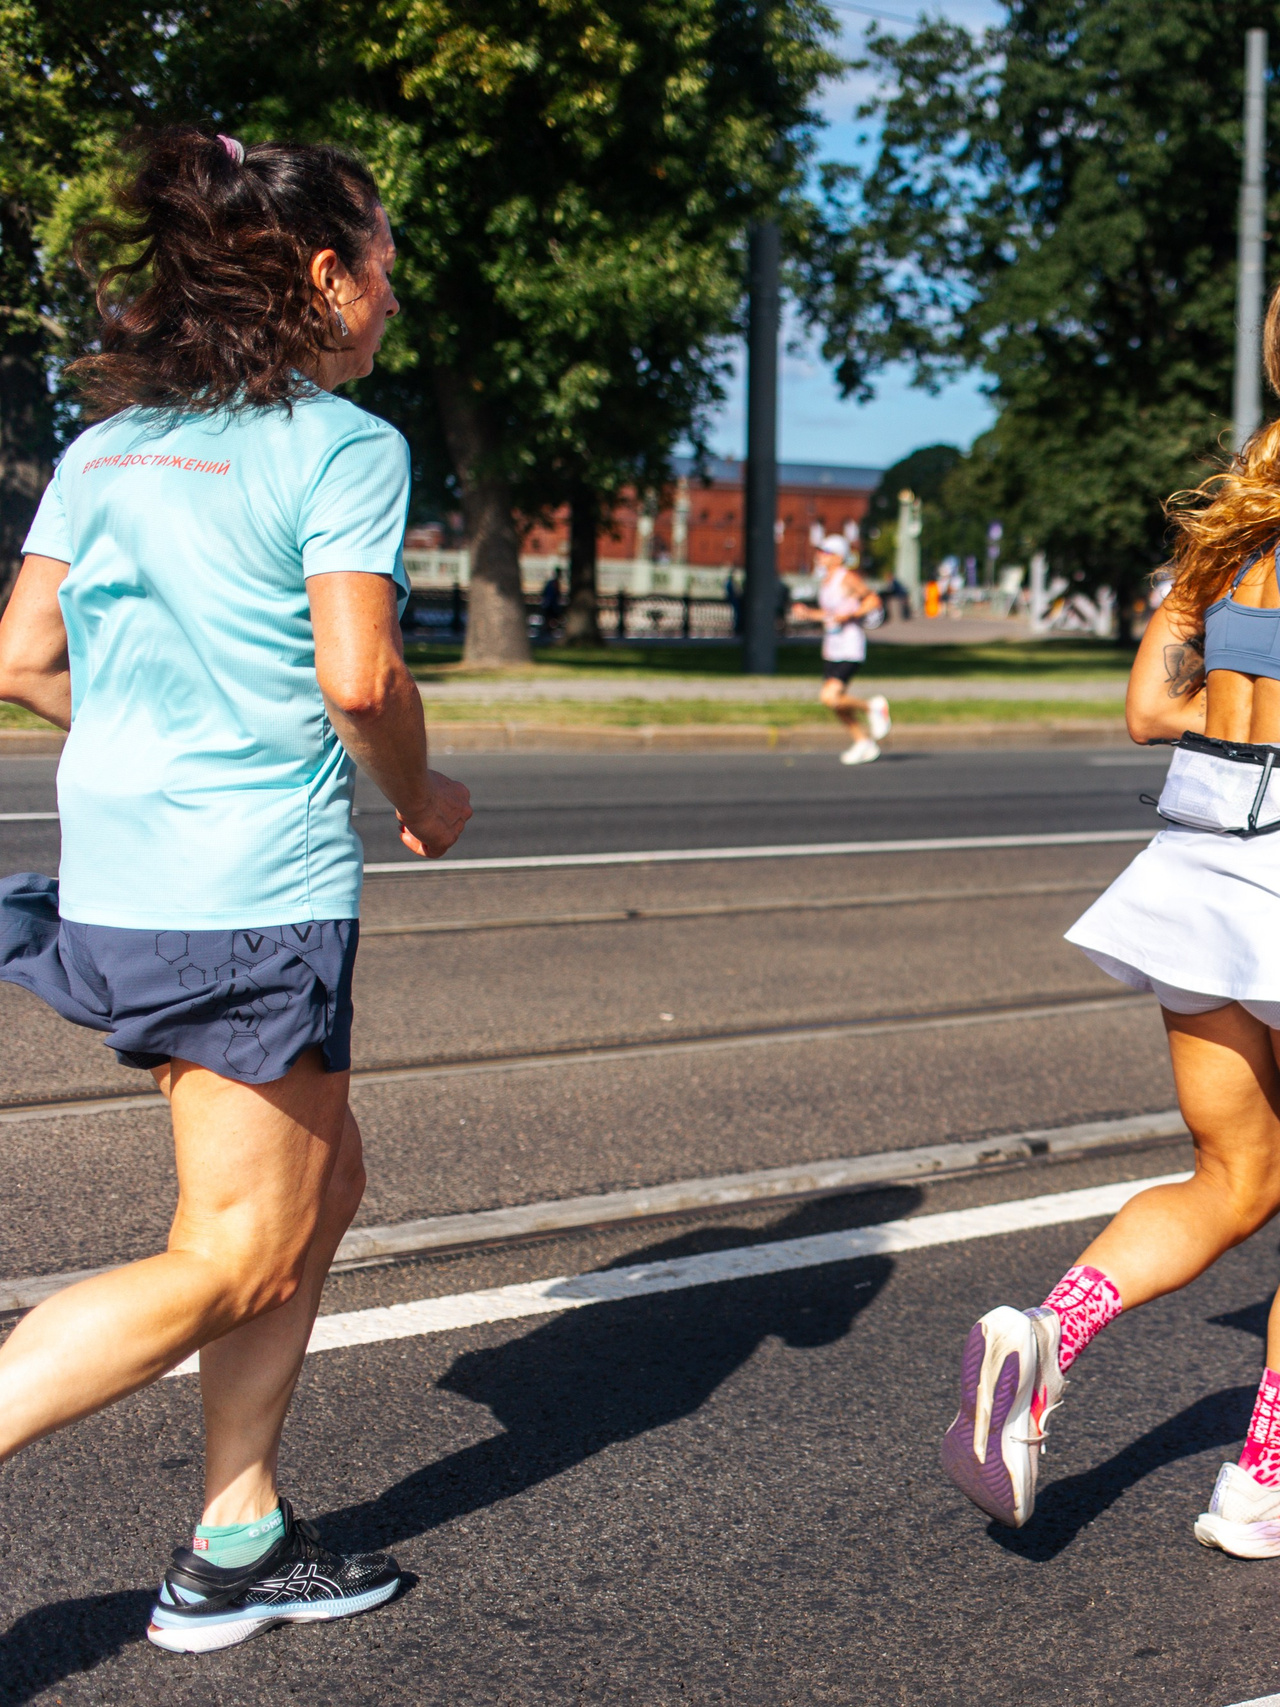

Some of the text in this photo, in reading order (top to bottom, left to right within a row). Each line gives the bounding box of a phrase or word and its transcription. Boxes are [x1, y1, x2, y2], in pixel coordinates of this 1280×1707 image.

[82, 454, 231, 476] ВРЕМЯ ДОСТИЖЕНИЙ
[1264, 1384, 1278, 1403] ME
[1259, 1402, 1272, 1418] BY
